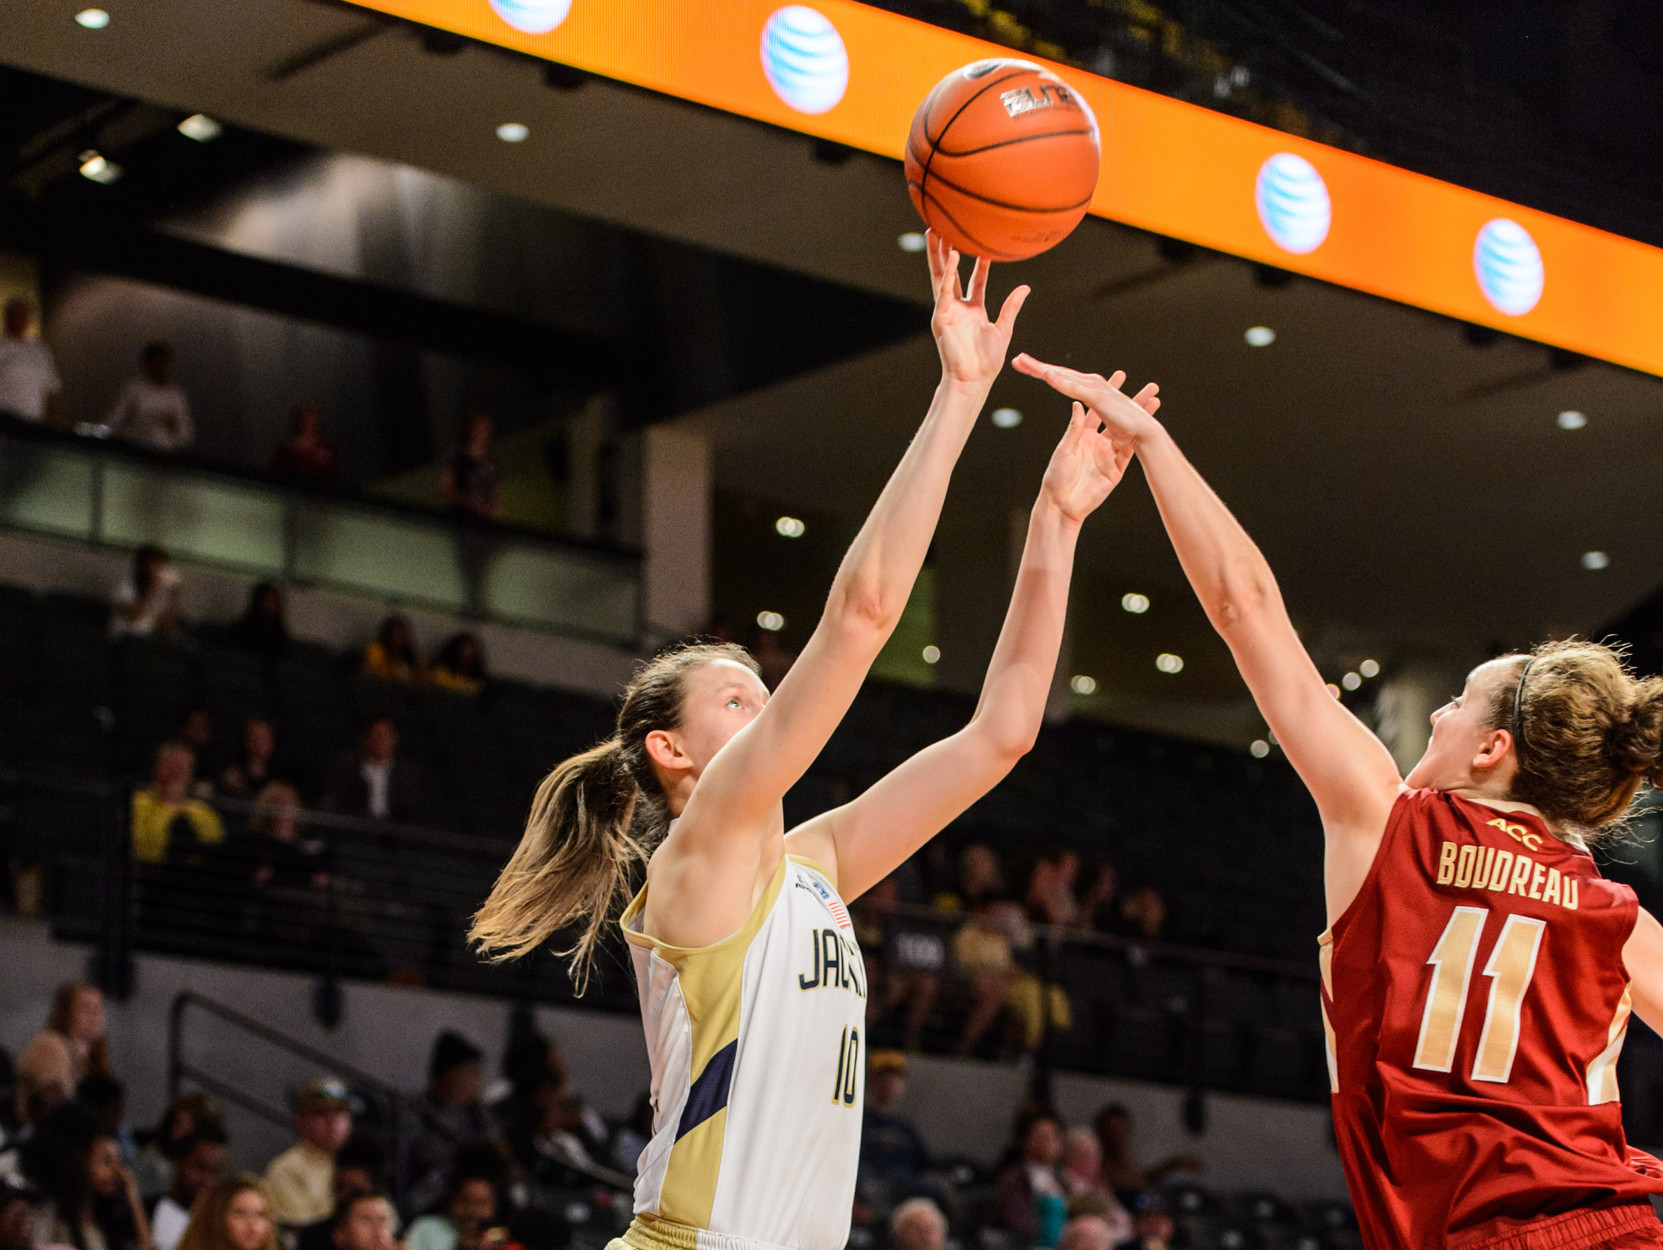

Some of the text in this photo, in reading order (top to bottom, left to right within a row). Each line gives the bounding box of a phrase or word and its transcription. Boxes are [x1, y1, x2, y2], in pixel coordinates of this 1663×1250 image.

[1486, 817, 1544, 852] ACC
[1436, 841, 1579, 910] BOUDREAU
[1412, 905, 1547, 1083] 11
[831, 1023, 859, 1109] 10
